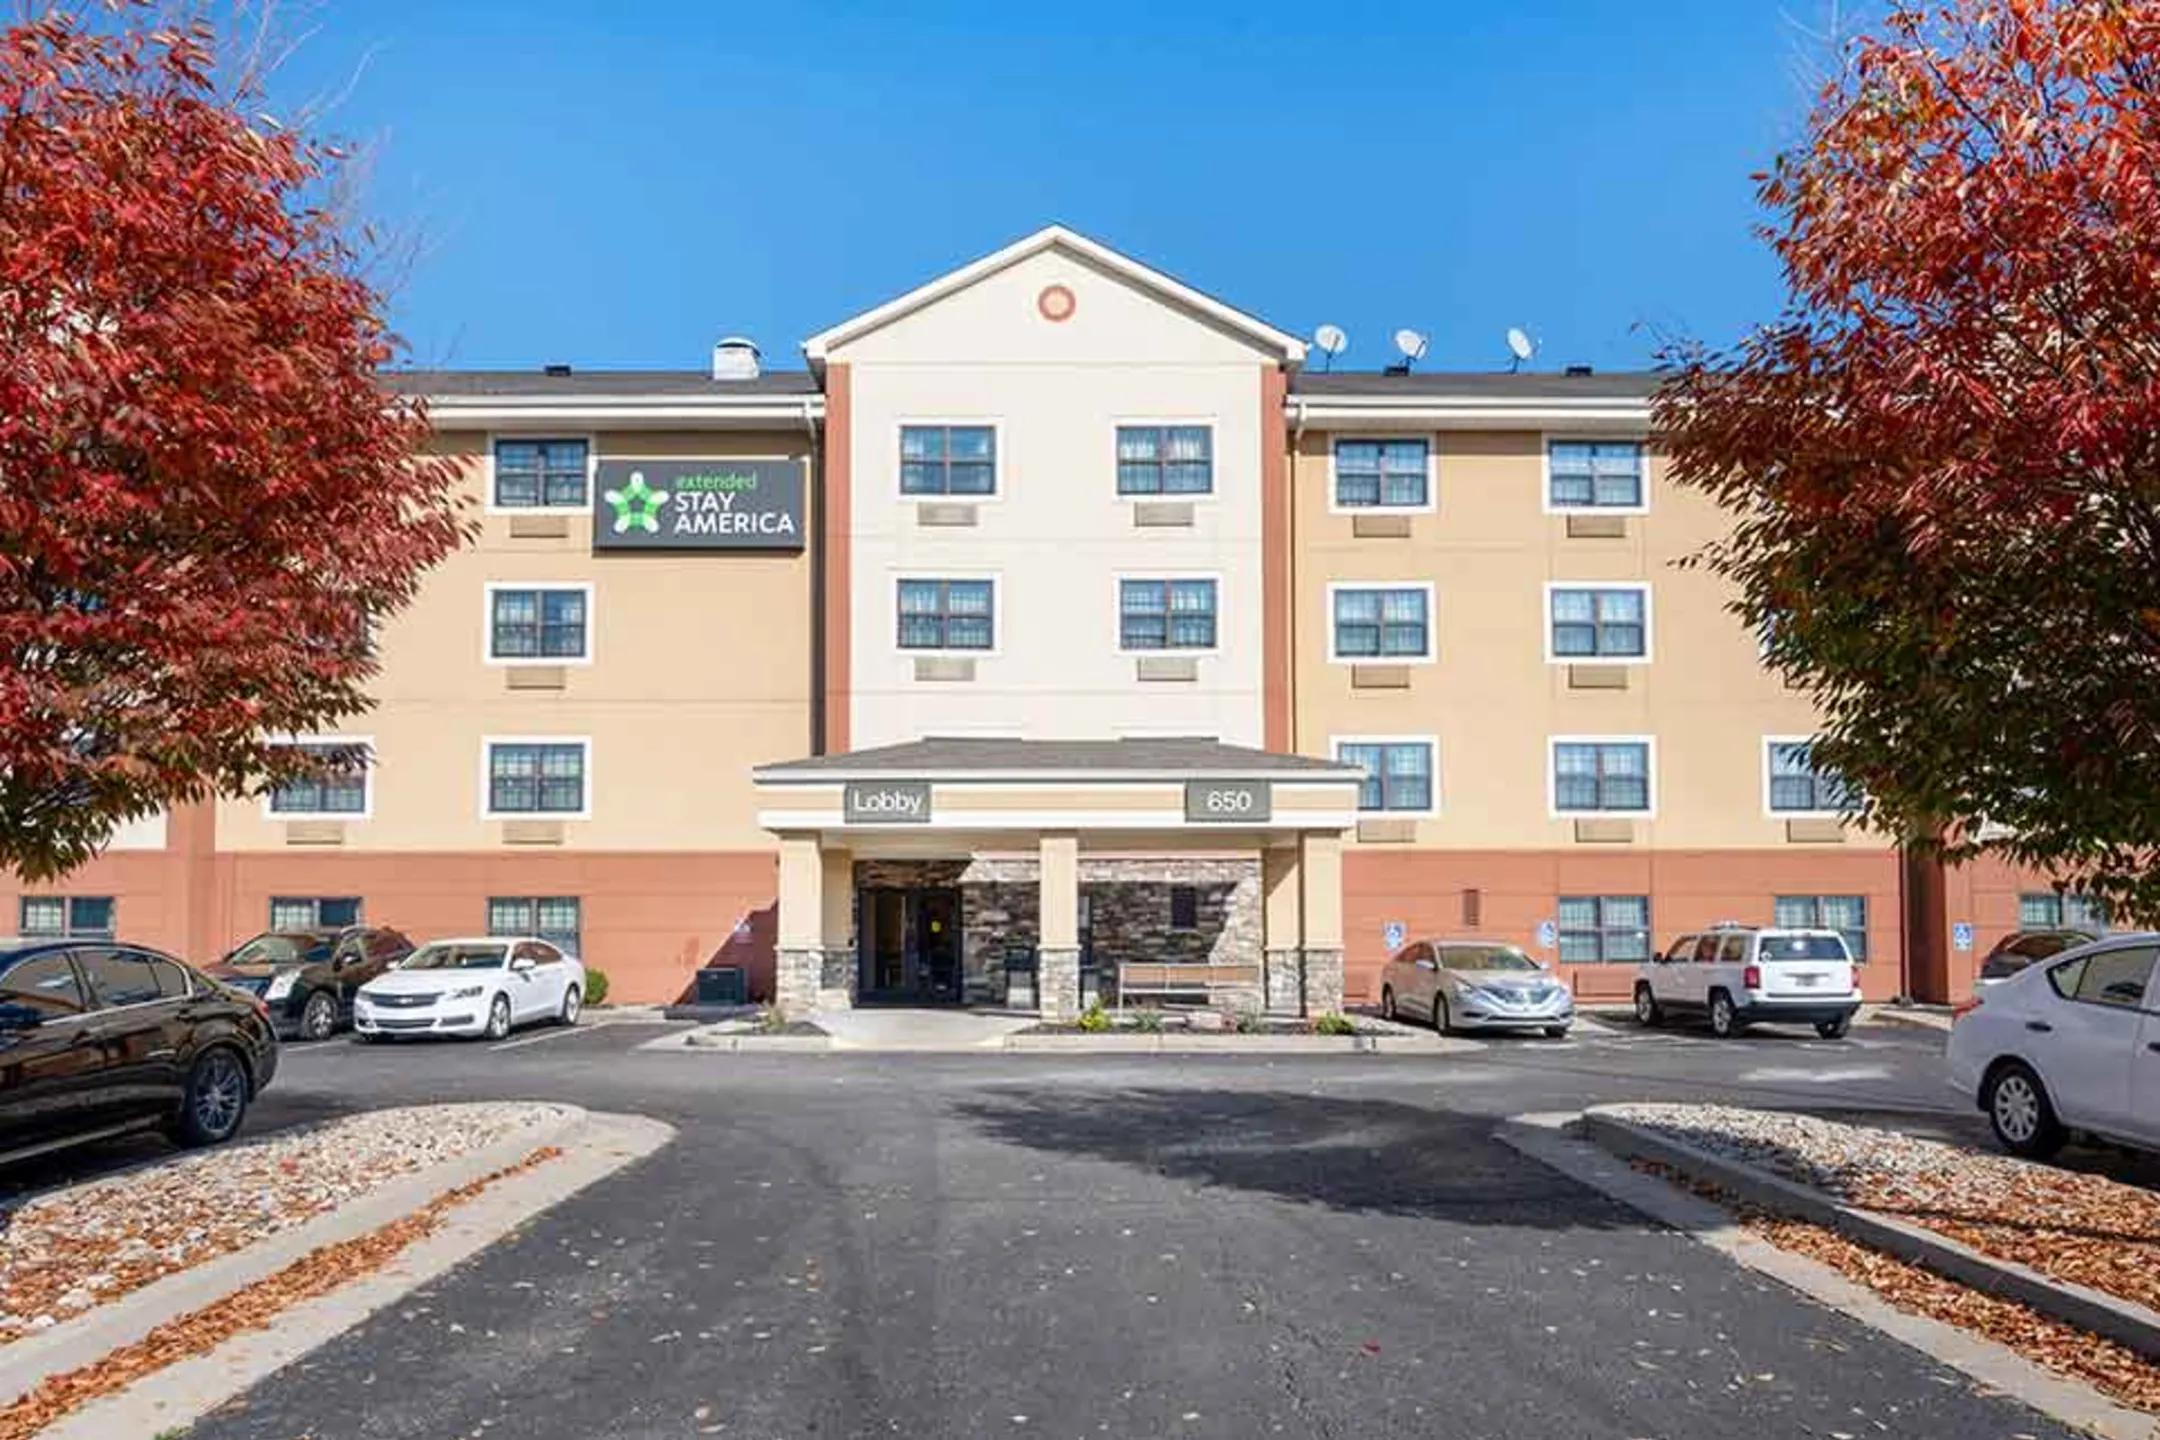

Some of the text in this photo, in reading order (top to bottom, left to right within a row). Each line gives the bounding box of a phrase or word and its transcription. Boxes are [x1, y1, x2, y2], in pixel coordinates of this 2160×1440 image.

[675, 472, 757, 490] extended
[674, 491, 736, 512] STAY
[673, 513, 795, 534] AMERICA
[853, 789, 923, 814] Lobby
[1207, 790, 1252, 812] 650
